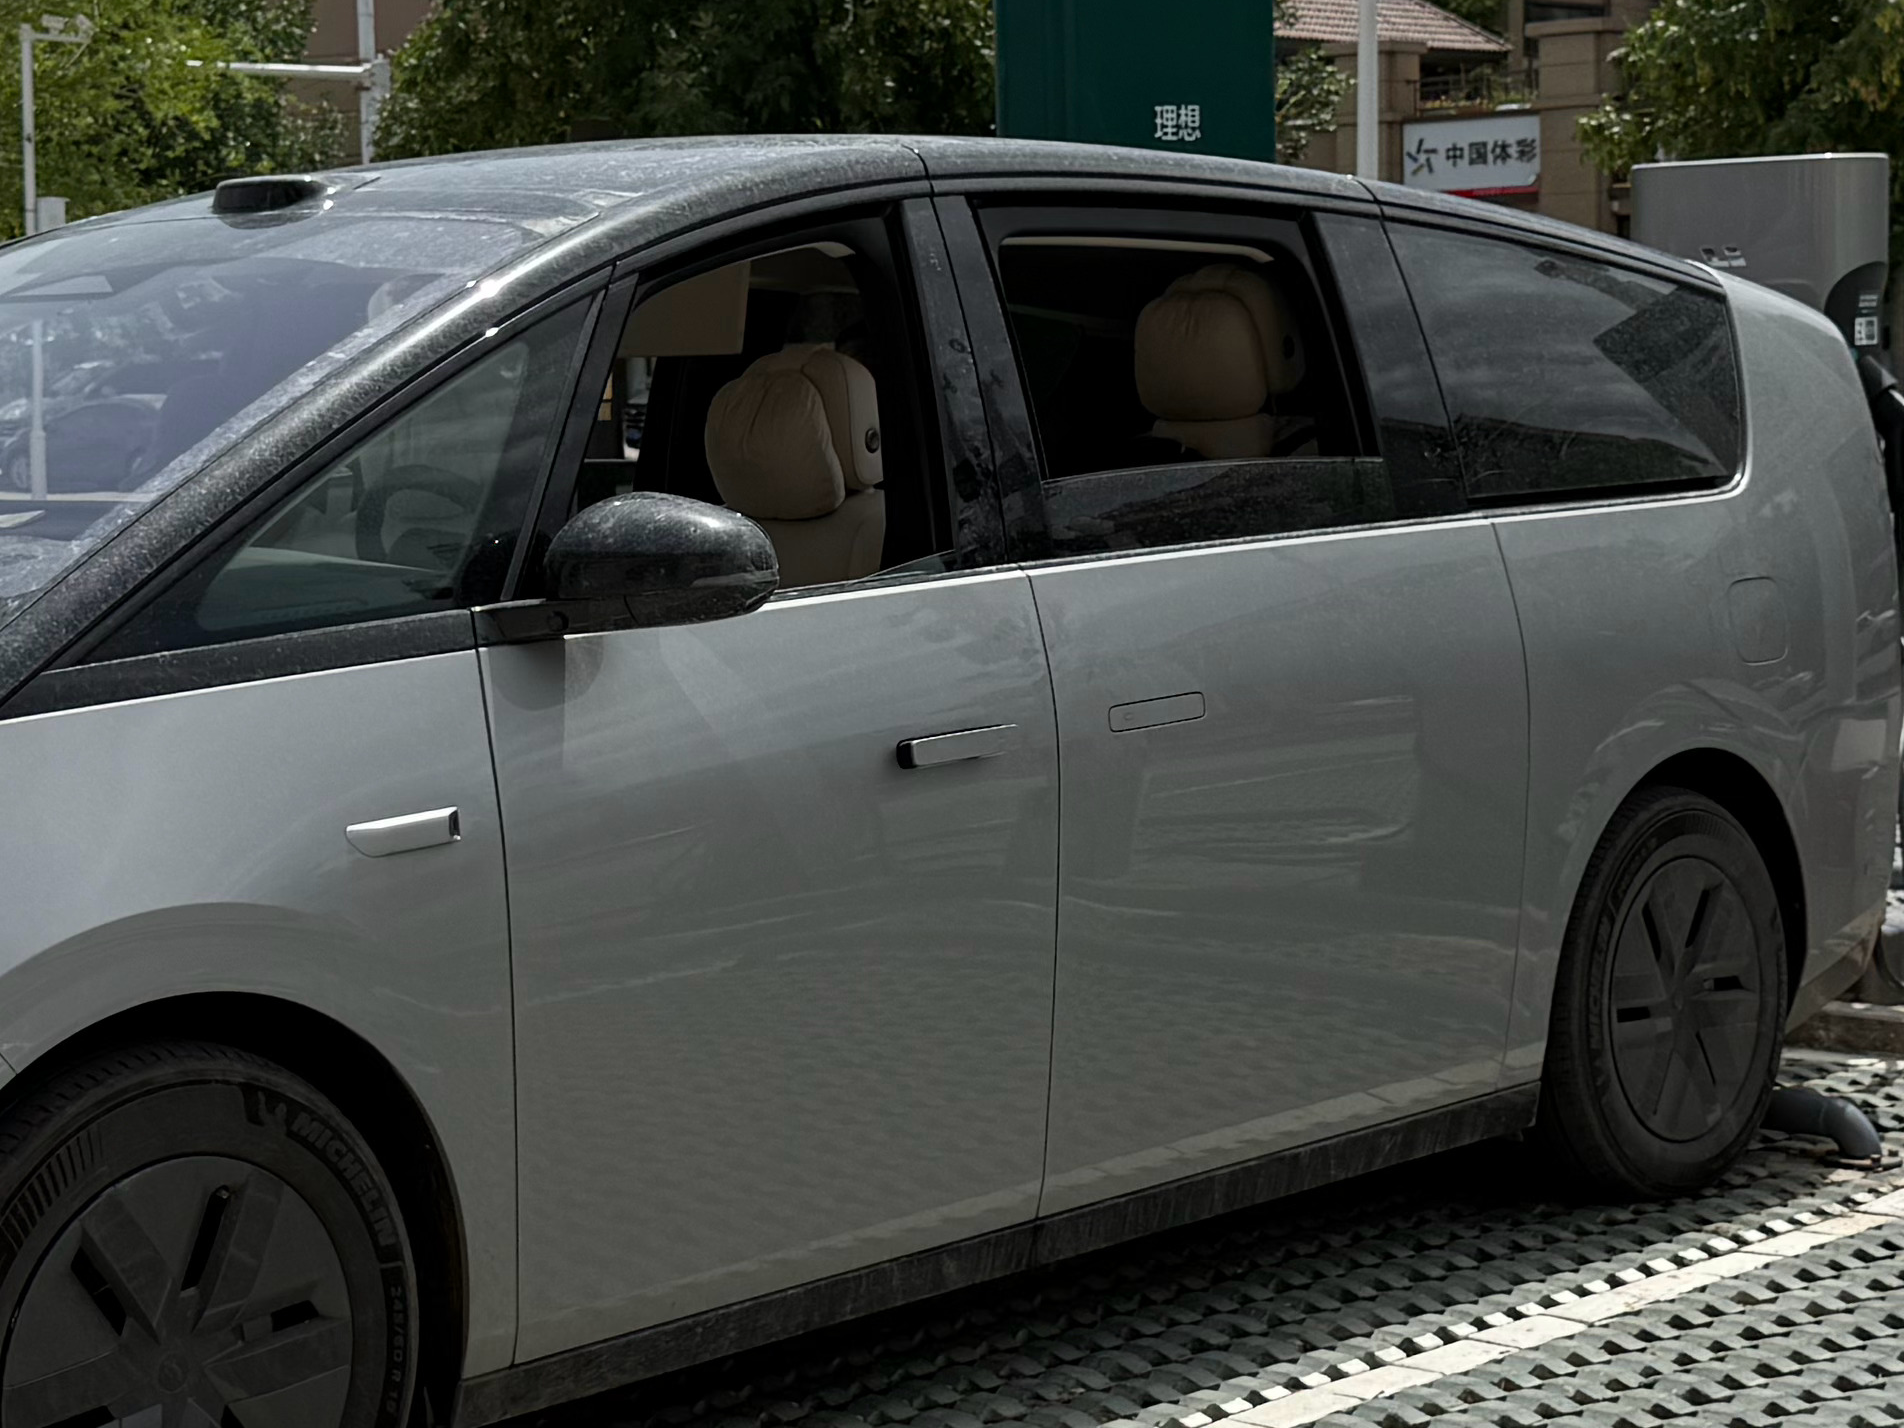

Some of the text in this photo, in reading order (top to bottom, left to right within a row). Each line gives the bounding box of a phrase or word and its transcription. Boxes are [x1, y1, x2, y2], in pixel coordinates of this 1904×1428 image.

[1153, 104, 1202, 142] 理想
[1445, 137, 1538, 168] 中国体彩
[289, 1110, 397, 1247] MICHELIN
